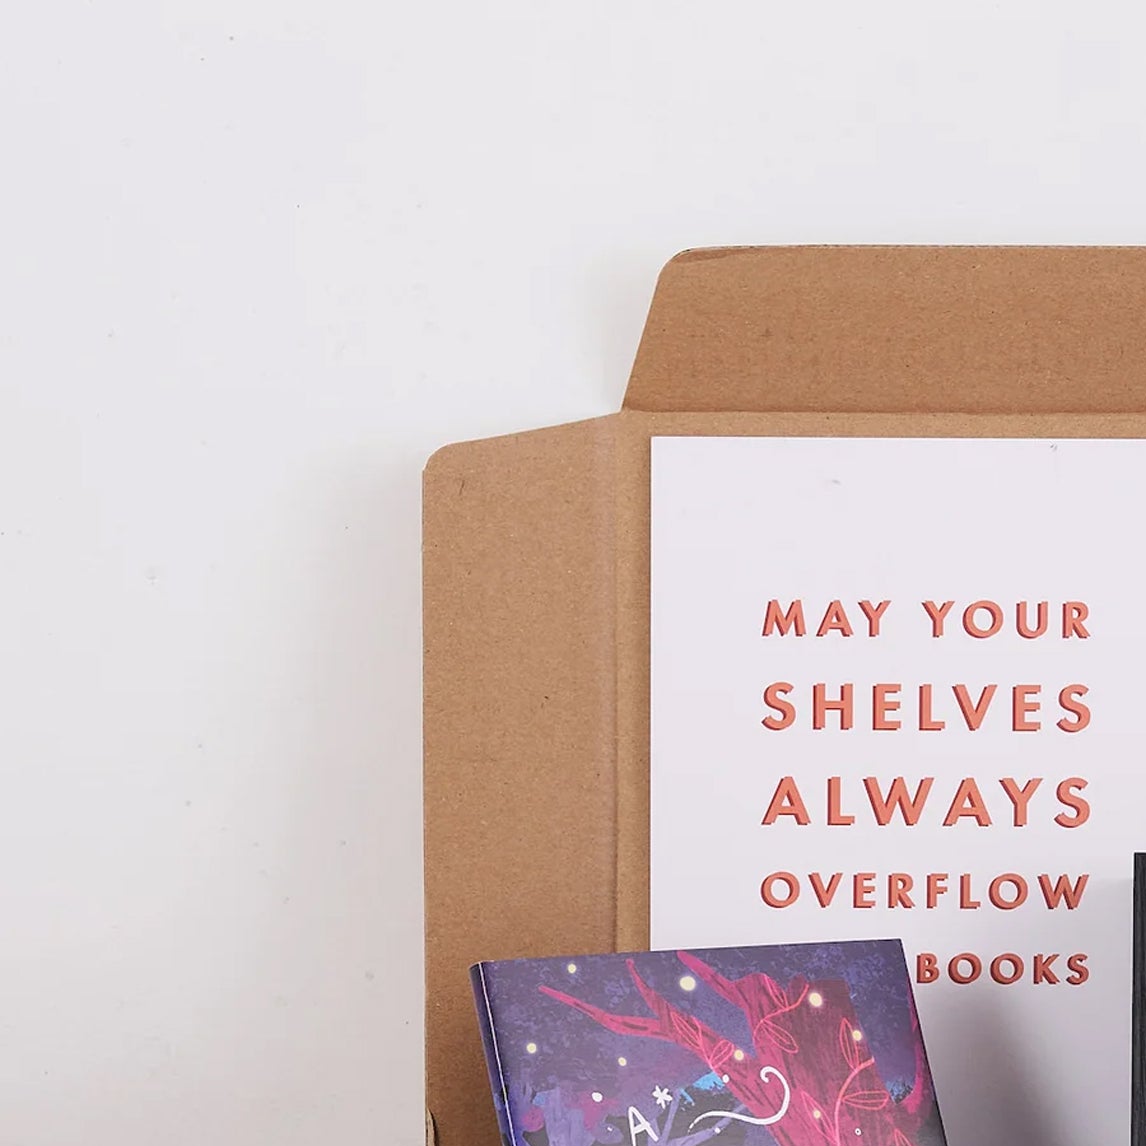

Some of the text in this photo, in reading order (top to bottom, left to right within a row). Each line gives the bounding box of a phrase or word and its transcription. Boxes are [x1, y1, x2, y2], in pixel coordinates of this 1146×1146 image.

[762, 600, 1091, 639] MAY YOUR
[761, 682, 1092, 733] SHELVES
[761, 776, 1091, 828] ALWAYS
[760, 871, 1090, 910] OVERFLOW
[916, 953, 1090, 985] BOOKS
